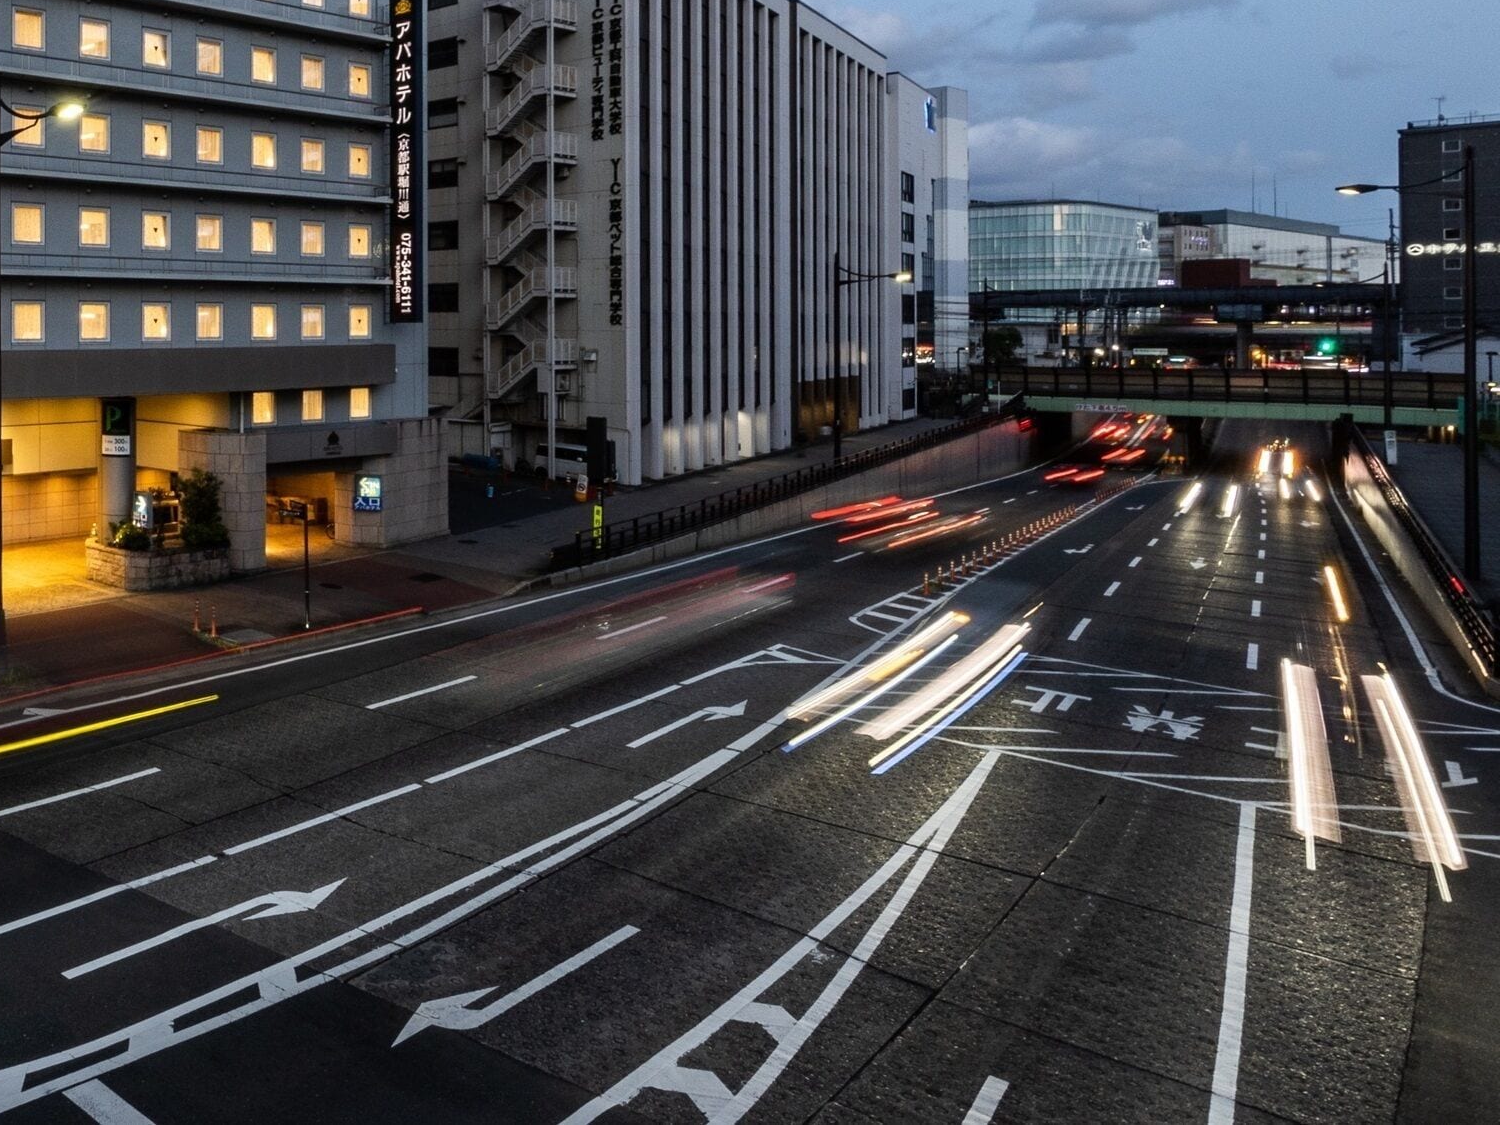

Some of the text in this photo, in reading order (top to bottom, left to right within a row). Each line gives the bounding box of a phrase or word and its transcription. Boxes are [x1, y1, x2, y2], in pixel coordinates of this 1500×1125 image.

[396, 21, 412, 124] アパホテル
[401, 232, 412, 313] 075-341-6111
[106, 406, 121, 431] P
[355, 497, 380, 506] 入口
